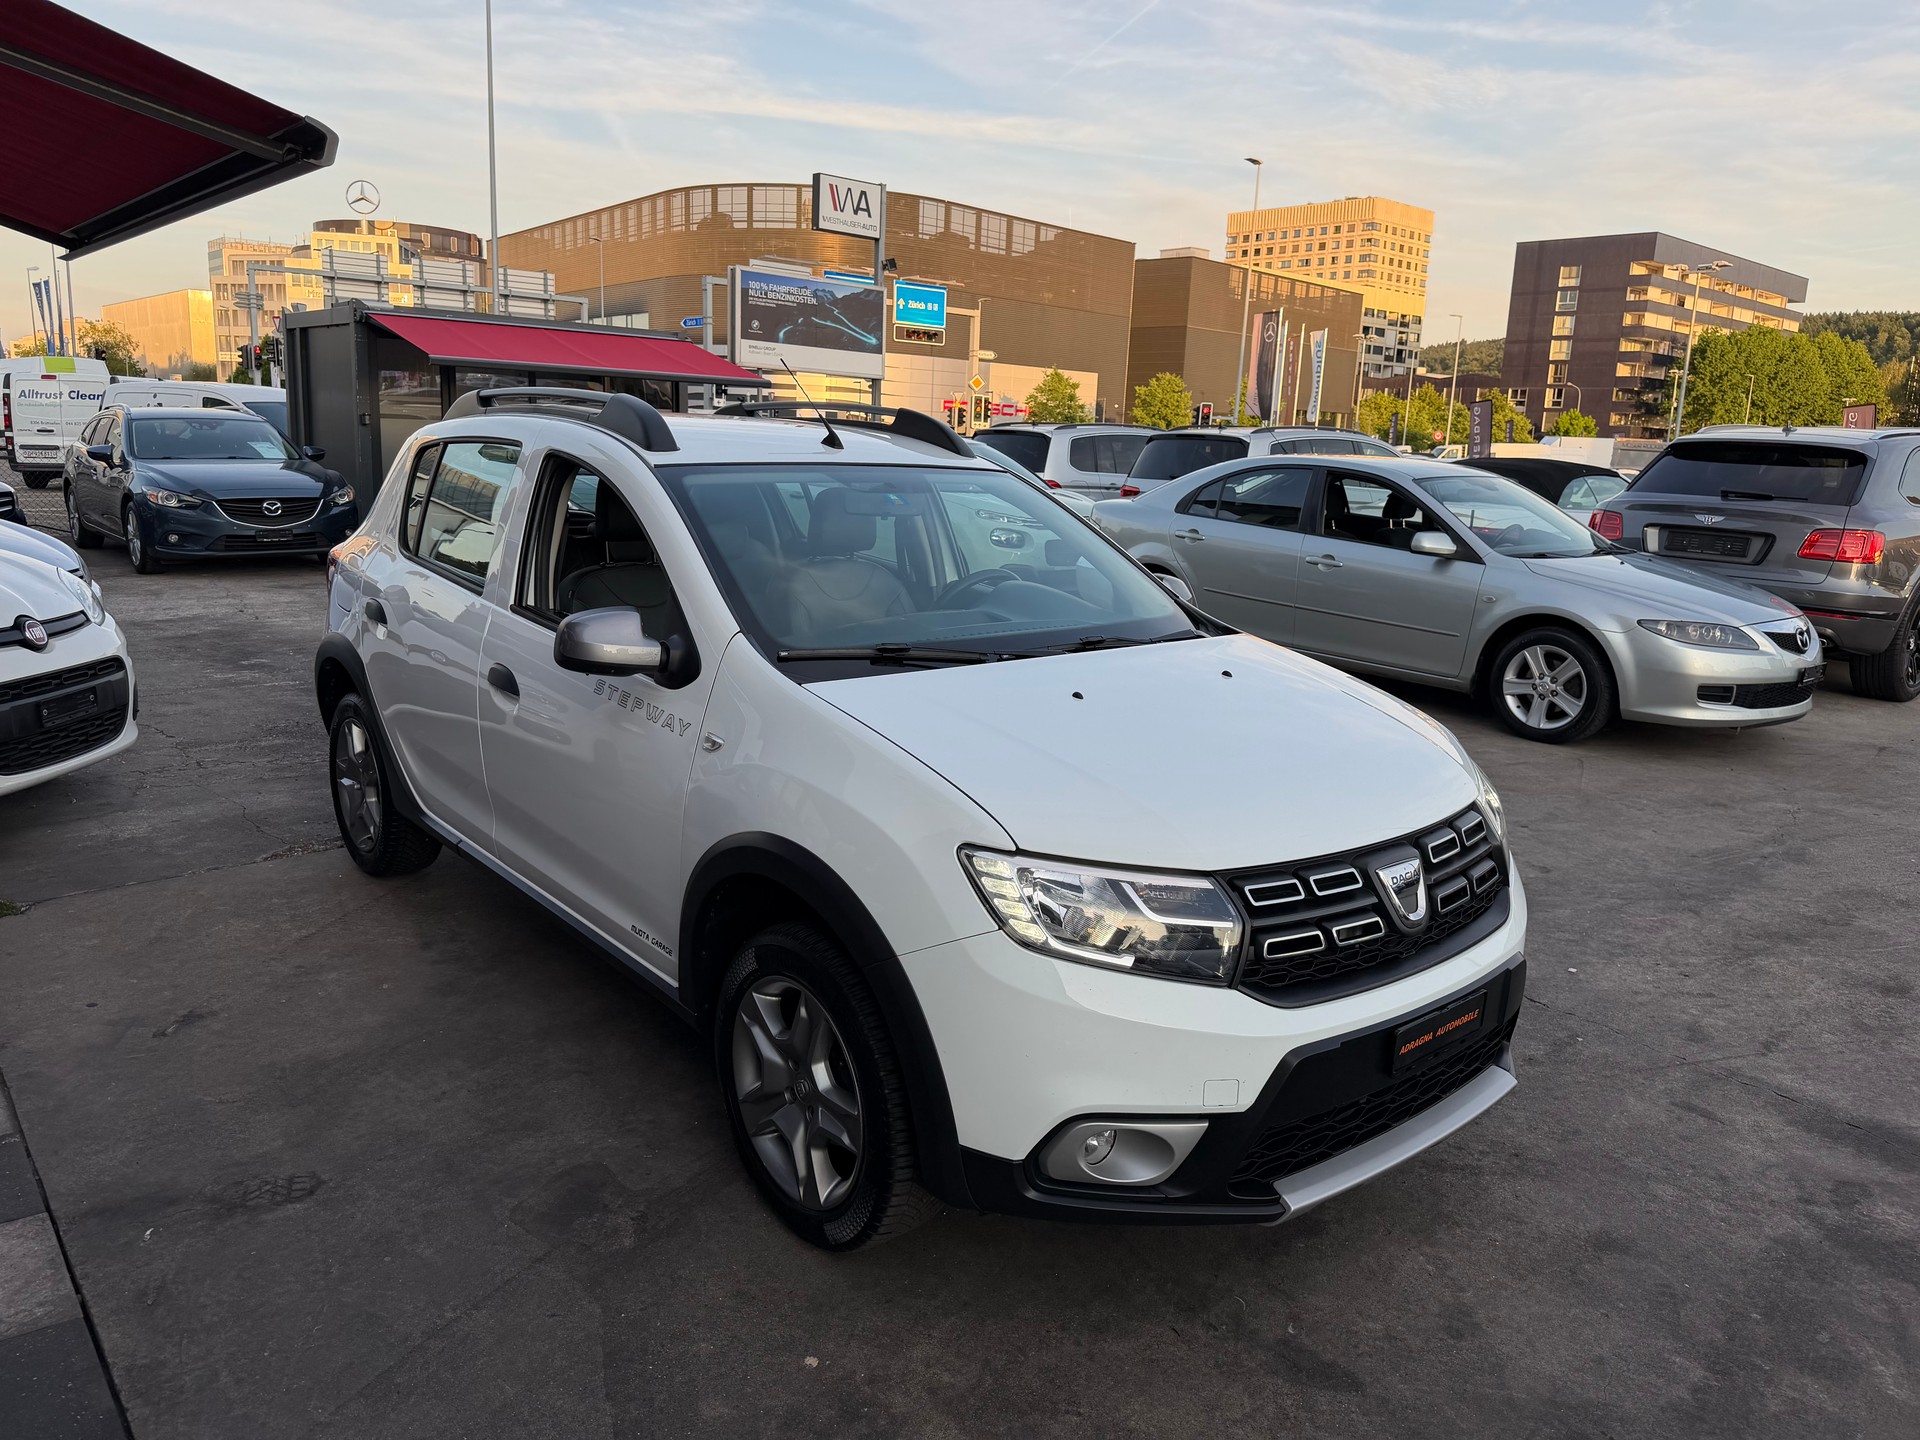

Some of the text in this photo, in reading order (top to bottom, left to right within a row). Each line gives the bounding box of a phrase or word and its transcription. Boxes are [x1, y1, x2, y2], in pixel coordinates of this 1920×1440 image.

[748, 289, 767, 298] NULL
[767, 291, 818, 305] BENZINKOSTEN.
[768, 283, 814, 297] FAHRFREUDE.
[17, 389, 64, 400] Alltrust
[593, 678, 692, 737] STEPWAY
[1390, 868, 1421, 886] DACIA
[651, 937, 673, 957] GARAGE
[1398, 1008, 1480, 1056] ADRAGNA AUTOMOBILE
